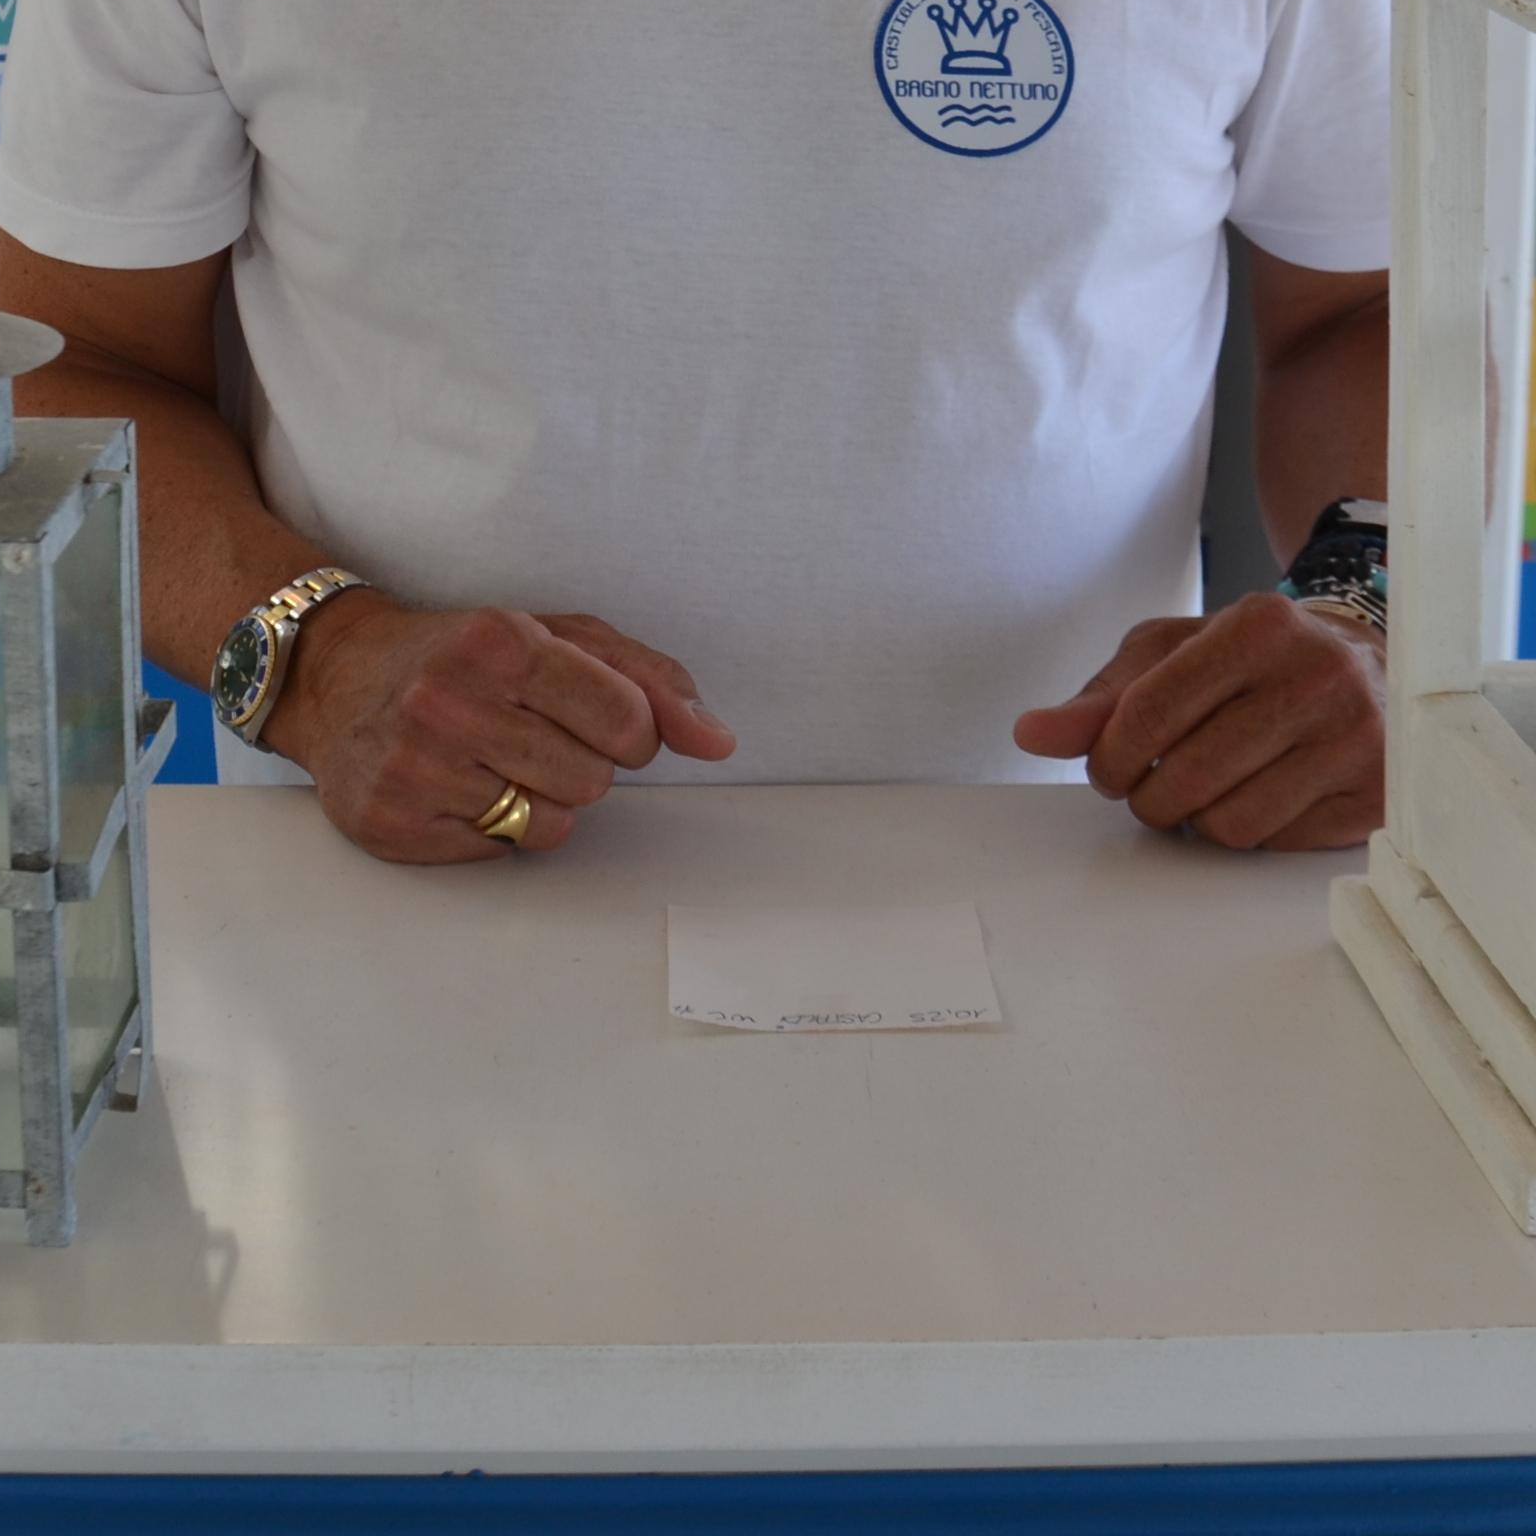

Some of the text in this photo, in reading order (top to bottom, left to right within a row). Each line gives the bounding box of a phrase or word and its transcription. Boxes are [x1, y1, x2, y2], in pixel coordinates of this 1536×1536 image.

[1023, 1, 1064, 75] PESCAIA
[895, 80, 1058, 101] BAGNO NETTUNO
